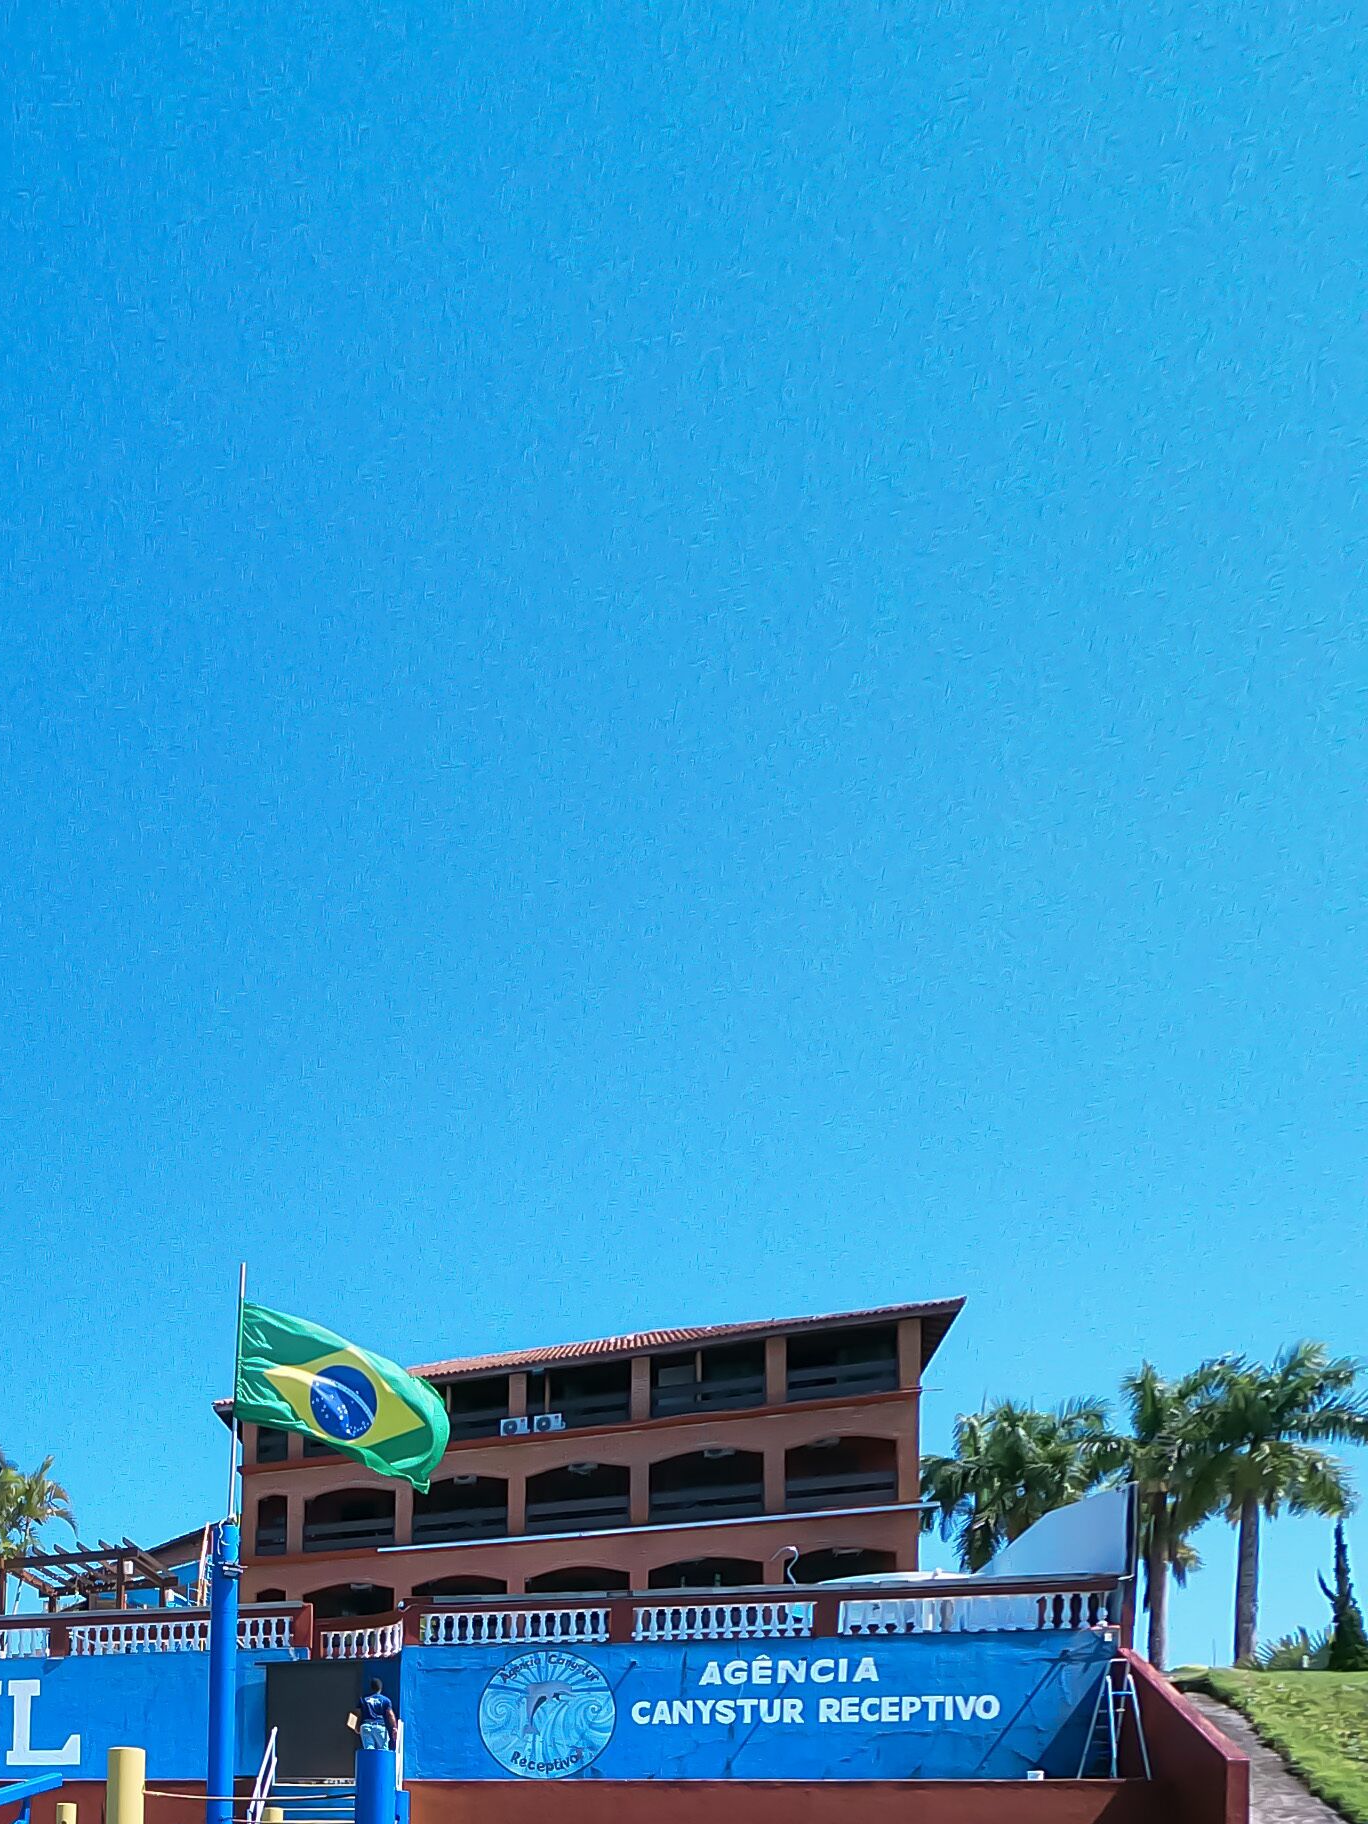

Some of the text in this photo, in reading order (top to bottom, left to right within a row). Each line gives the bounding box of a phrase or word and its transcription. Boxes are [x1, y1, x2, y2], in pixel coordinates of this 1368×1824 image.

[699, 1655, 879, 1686] AGÊNCIA
[631, 1695, 1000, 1726] CANYSTUR RECEPTIVO
[510, 1750, 582, 1774] Receptivo
